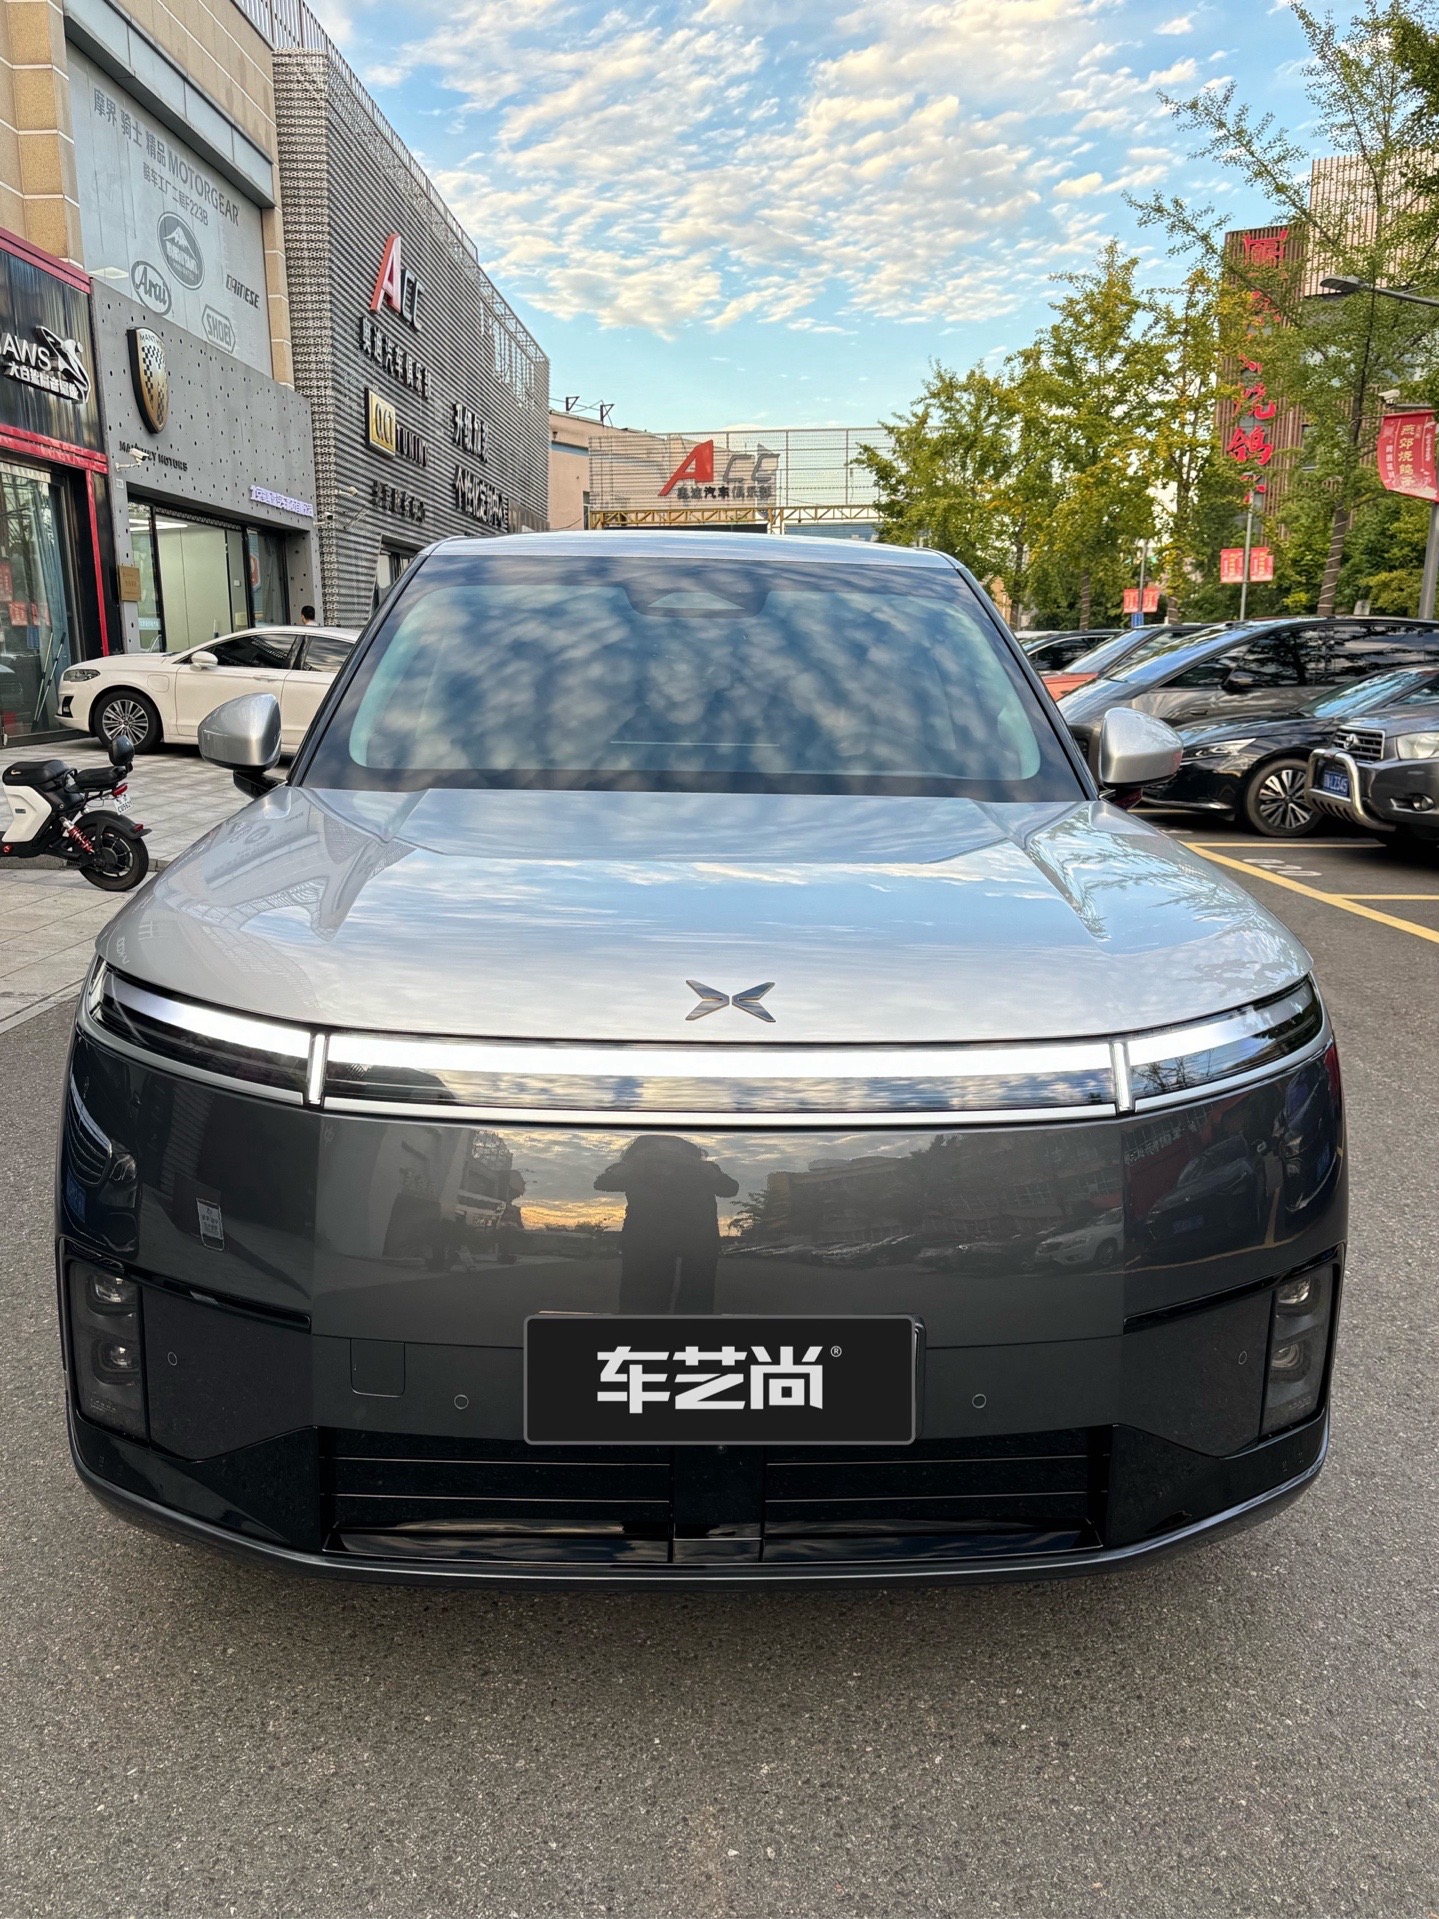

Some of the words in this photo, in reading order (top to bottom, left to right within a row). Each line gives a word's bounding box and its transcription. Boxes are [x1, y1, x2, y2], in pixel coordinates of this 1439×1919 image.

[121, 109, 143, 148] 骑士
[145, 131, 167, 168] 精品
[168, 151, 239, 227] MOTORGEAR
[135, 266, 167, 305] Arai
[206, 314, 232, 347] SHOEI
[0, 333, 52, 371] AWS
